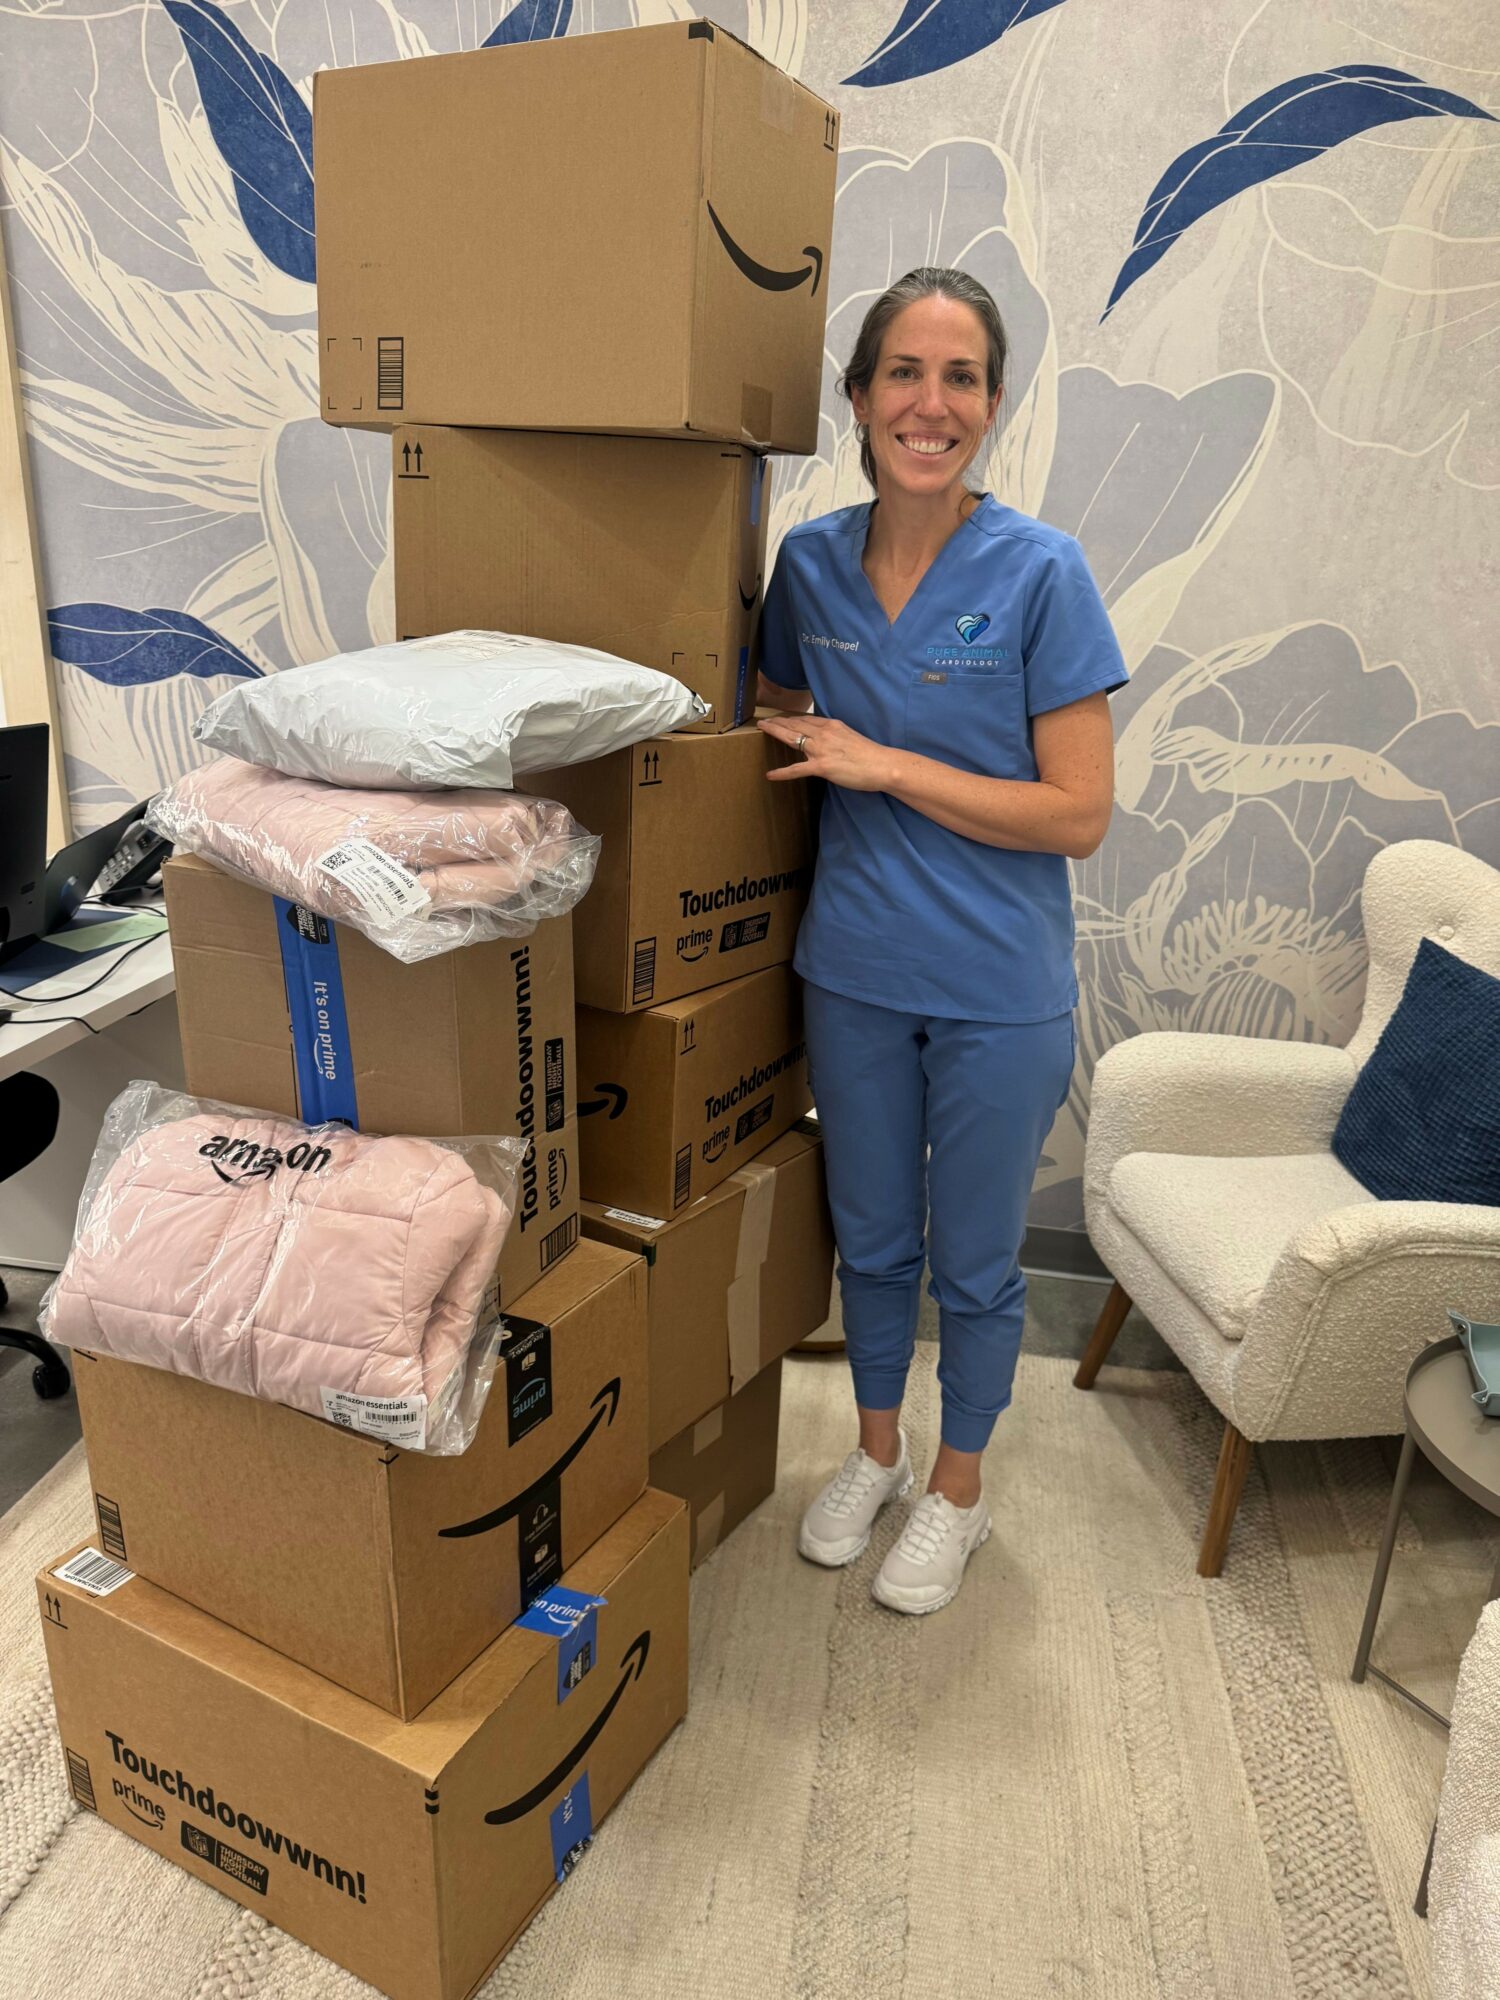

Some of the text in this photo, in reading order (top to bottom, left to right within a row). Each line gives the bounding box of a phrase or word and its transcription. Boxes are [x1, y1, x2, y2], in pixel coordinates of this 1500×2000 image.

[811, 634, 830, 648] Emily
[831, 638, 860, 652] Chapel
[926, 647, 1010, 658] PURE ANIMAL
[383, 861, 415, 889] essentials
[676, 928, 713, 955] prime
[313, 980, 336, 1081] It's on prime
[702, 1125, 731, 1161] prime
[546, 1148, 561, 1211] prime
[335, 1392, 365, 1407] amazon
[365, 1401, 409, 1410] essentials
[512, 1381, 547, 1418] prime
[111, 1776, 166, 1821] prime
[104, 1729, 368, 1905] Touchdoowwnn!
[220, 1844, 266, 1877] THURSDAY
[220, 1853, 247, 1874] NIGHT
[220, 1860, 262, 1891] FOOTBALL
